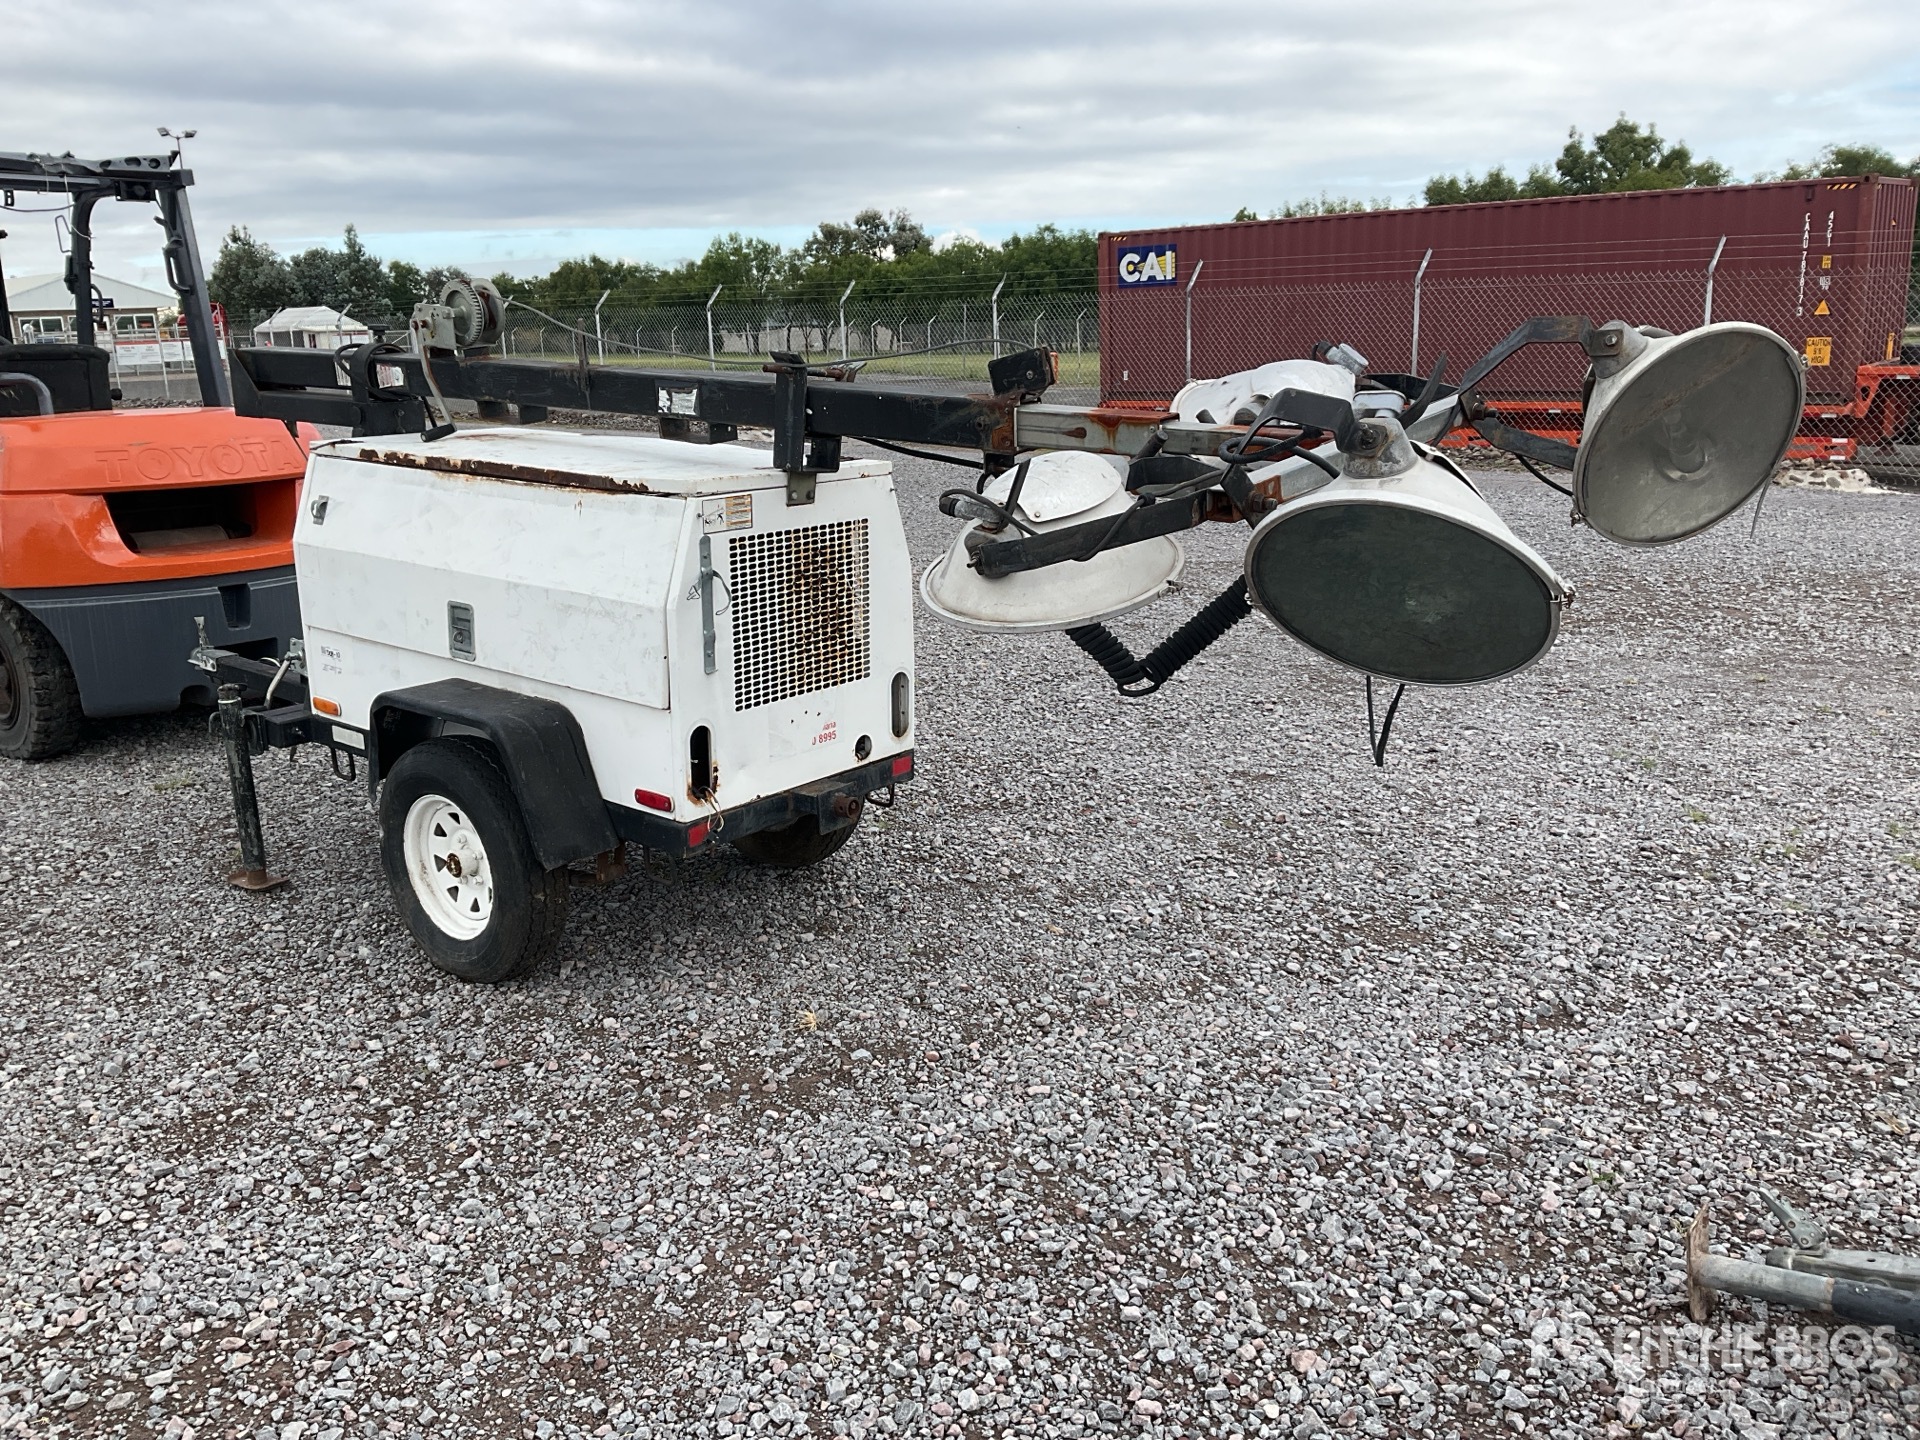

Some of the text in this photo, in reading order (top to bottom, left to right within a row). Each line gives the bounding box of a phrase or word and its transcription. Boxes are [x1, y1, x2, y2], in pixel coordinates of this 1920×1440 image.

[1803, 213, 1811, 248] CAAU
[1119, 251, 1172, 282] CAI
[94, 439, 303, 483] TOYOTA
[818, 730, 836, 743] 8995
